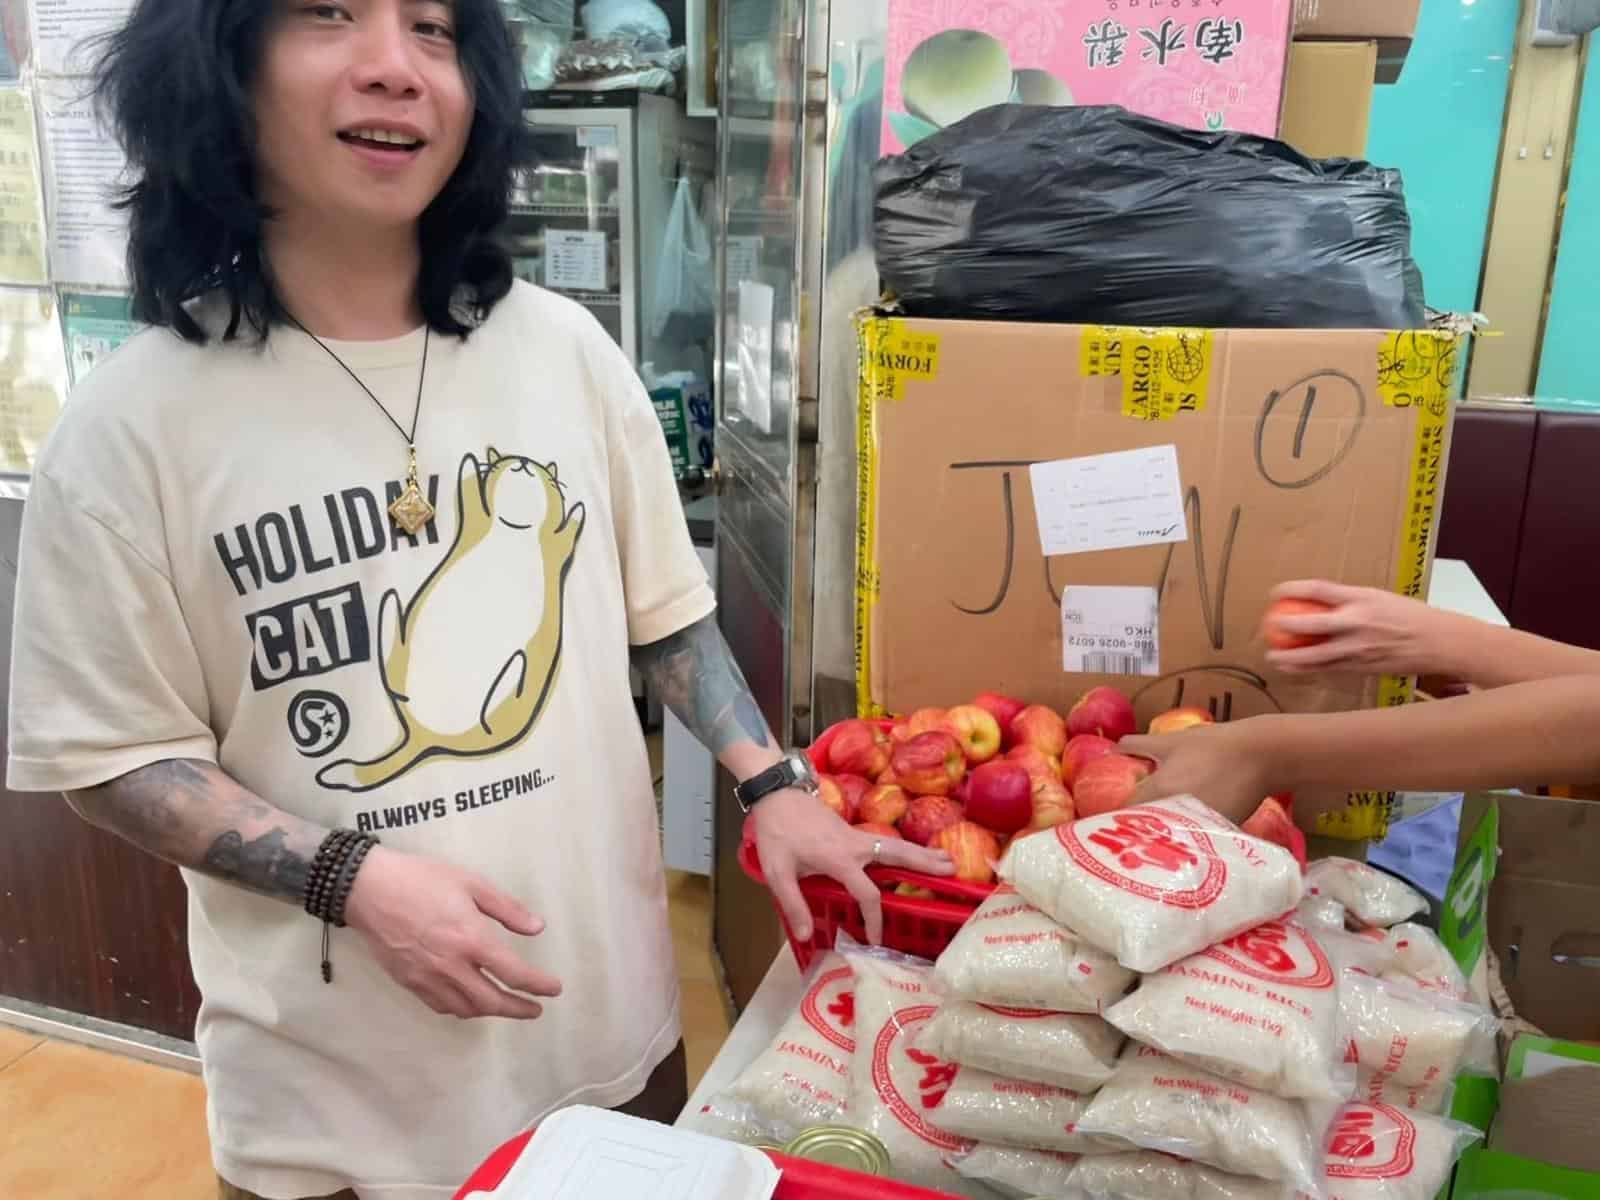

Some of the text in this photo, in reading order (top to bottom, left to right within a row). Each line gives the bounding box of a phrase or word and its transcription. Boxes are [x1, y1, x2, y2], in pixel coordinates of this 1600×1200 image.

[1082, 18, 1243, 68] 南水梨
[253, 590, 357, 681] CAT
[1124, 626, 1153, 636] HKG
[356, 767, 557, 832] ALWAYS SLEEPING...
[1166, 963, 1313, 1018] JASMINE RICE
[1184, 995, 1208, 1009] Net
[1261, 1015, 1284, 1037] 1kg
[776, 1040, 849, 1077] JASMINE
[1153, 1075, 1178, 1088] Net
